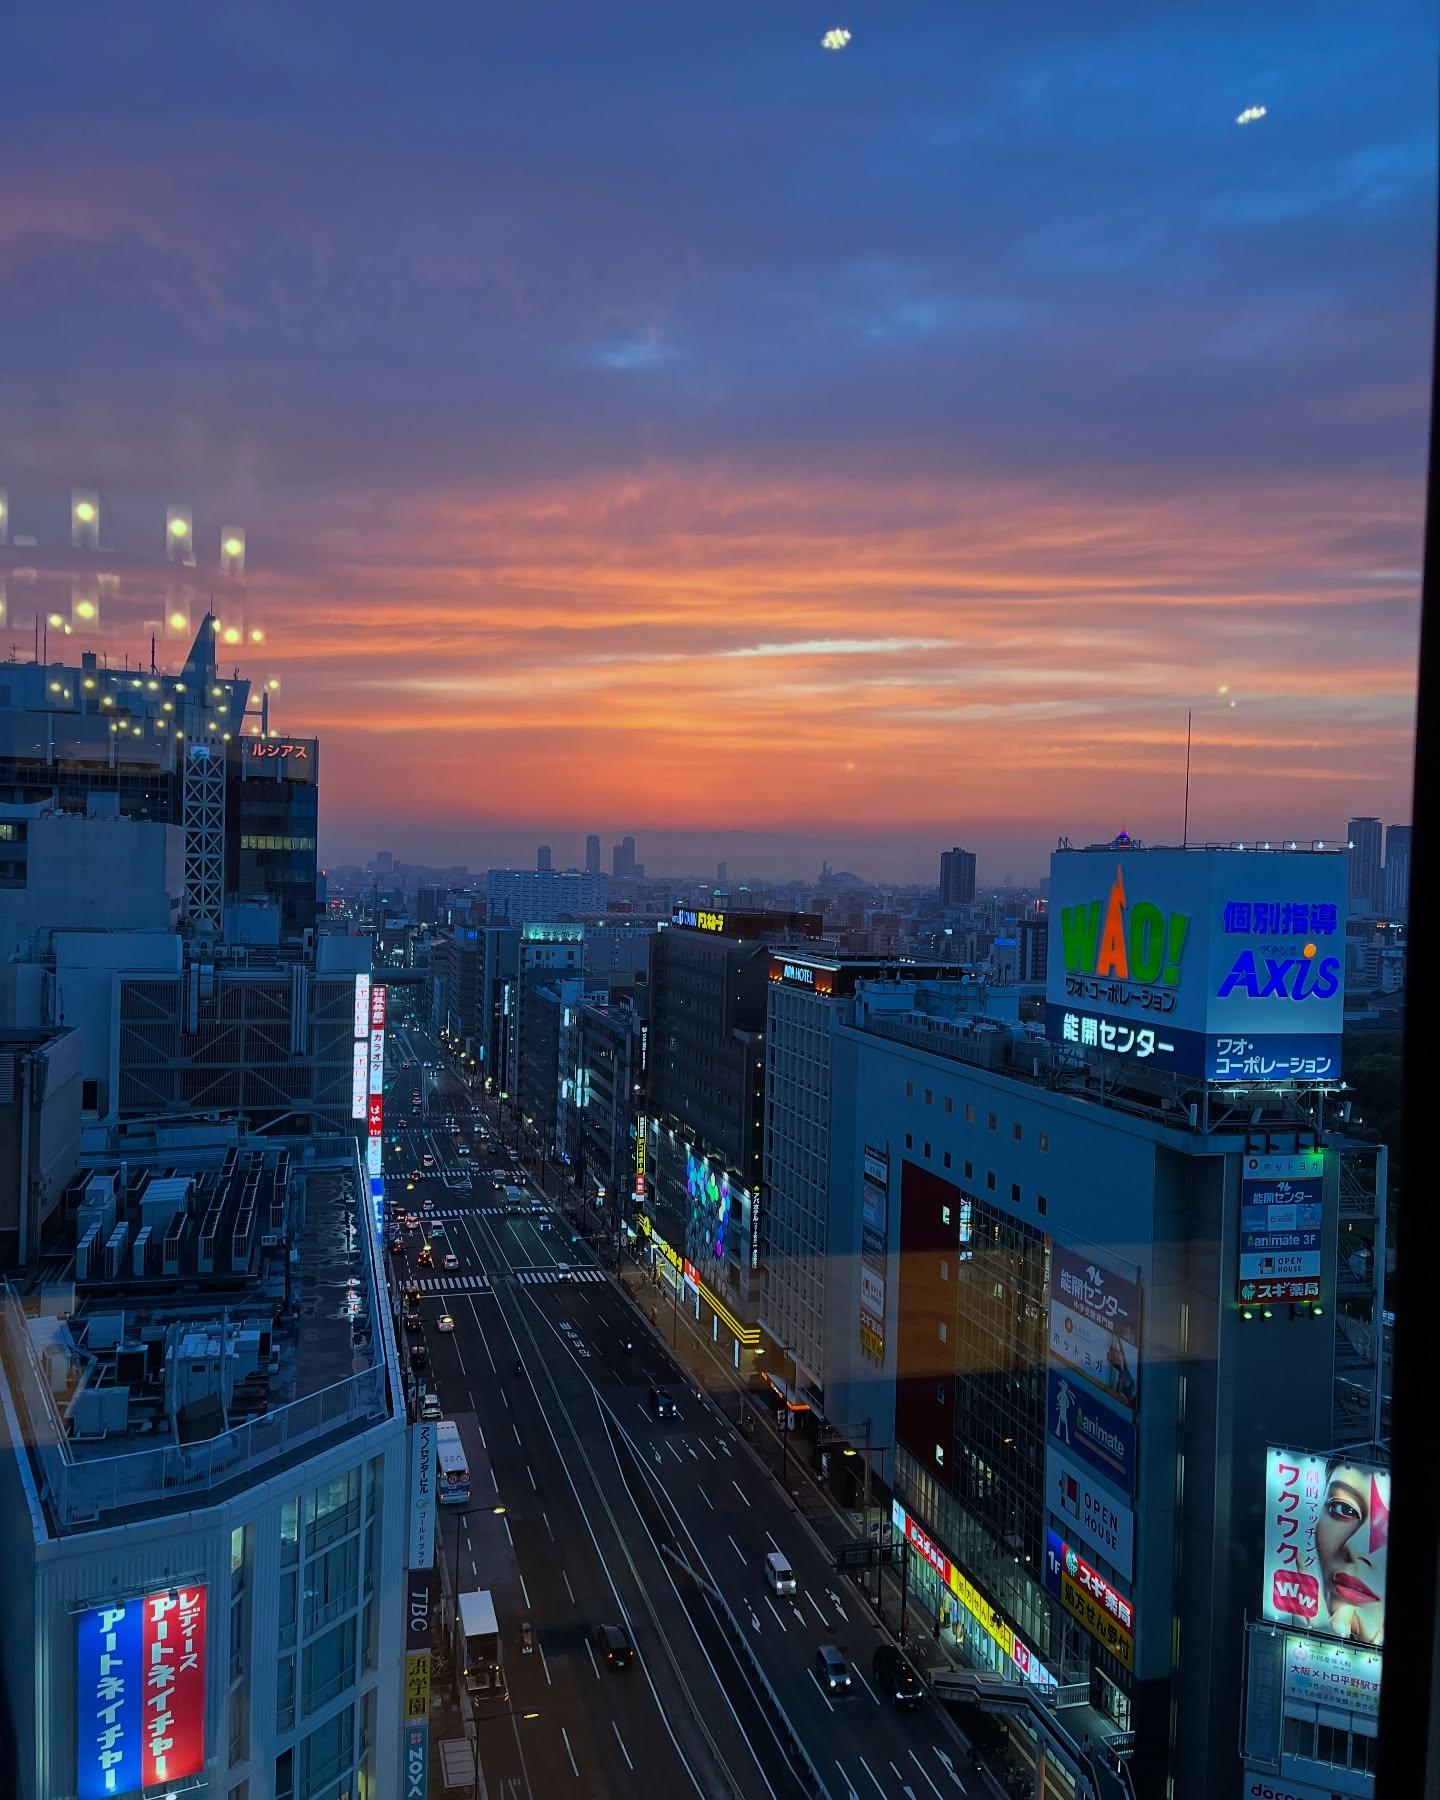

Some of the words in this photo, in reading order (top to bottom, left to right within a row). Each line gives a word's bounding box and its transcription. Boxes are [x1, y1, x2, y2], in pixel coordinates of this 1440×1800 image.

[252, 743, 308, 758] ルシアス
[1060, 862, 1191, 986] WAO!
[1222, 900, 1338, 936] 個別指導
[795, 967, 814, 984] HOTEL
[1064, 977, 1177, 1013] ワオ・コーポレーション
[372, 1034, 382, 1071] カラオケ
[1062, 1012, 1175, 1057] 能開センター
[1215, 1055, 1332, 1074] コーポレーション
[1263, 1160, 1320, 1171] ホットヨガ
[752, 1192, 760, 1222] アパホテル
[1253, 1191, 1313, 1205] 能開センター
[1254, 1232, 1300, 1247] animate
[1303, 1234, 1316, 1246] 3F
[1277, 1265, 1302, 1273] HOUSE
[1278, 1256, 1302, 1265] OPEN
[1060, 1269, 1128, 1317] 能開センター
[1257, 1282, 1319, 1298] スギ薬局
[1053, 1333, 1104, 1373] ホットヨガ
[1082, 1414, 1126, 1457] animate
[1084, 1492, 1118, 1533] OPEN
[1084, 1511, 1118, 1551] HOUSE
[1276, 1463, 1300, 1565] ワクワク
[1047, 1550, 1061, 1575] 1F
[411, 1587, 429, 1632] TBC
[1079, 1565, 1131, 1628] スギ薬局
[178, 1593, 200, 1673] レディース
[1065, 1581, 1129, 1660] 処方せん受付
[96, 1608, 125, 1790] アートネイチャー
[147, 1597, 176, 1778] アートネイチャー
[408, 1656, 428, 1716] 浜学園
[408, 1746, 423, 1798] NOVA
